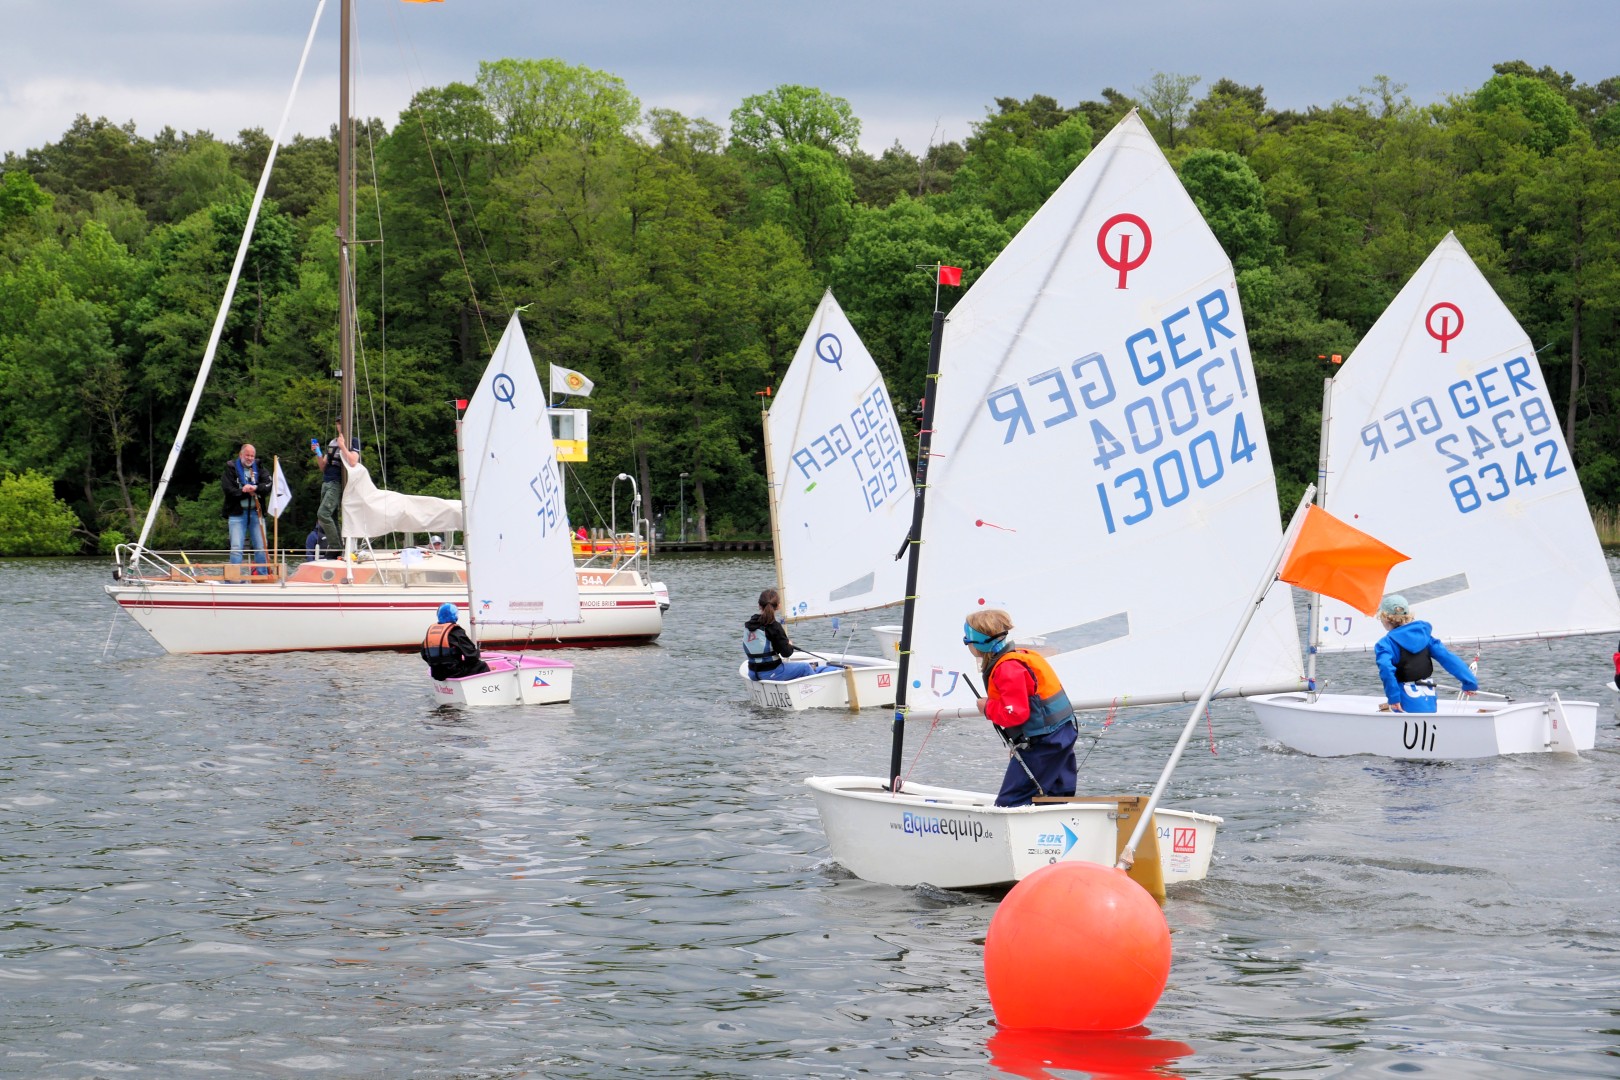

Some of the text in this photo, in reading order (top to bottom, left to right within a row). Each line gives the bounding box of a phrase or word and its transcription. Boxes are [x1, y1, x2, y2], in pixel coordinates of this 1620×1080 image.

[1125, 288, 1237, 386] GER
[1448, 356, 1537, 420] GER
[862, 449, 907, 513] 12137
[1096, 411, 1257, 534] 13004
[1449, 439, 1567, 514] 8342
[537, 485, 560, 538] 7517
[482, 684, 501, 694] SCK
[761, 683, 793, 709] Luke
[1403, 720, 1437, 752] Uli
[890, 811, 993, 842] www.aquaequip.de
[1038, 834, 1064, 844] ZOK
